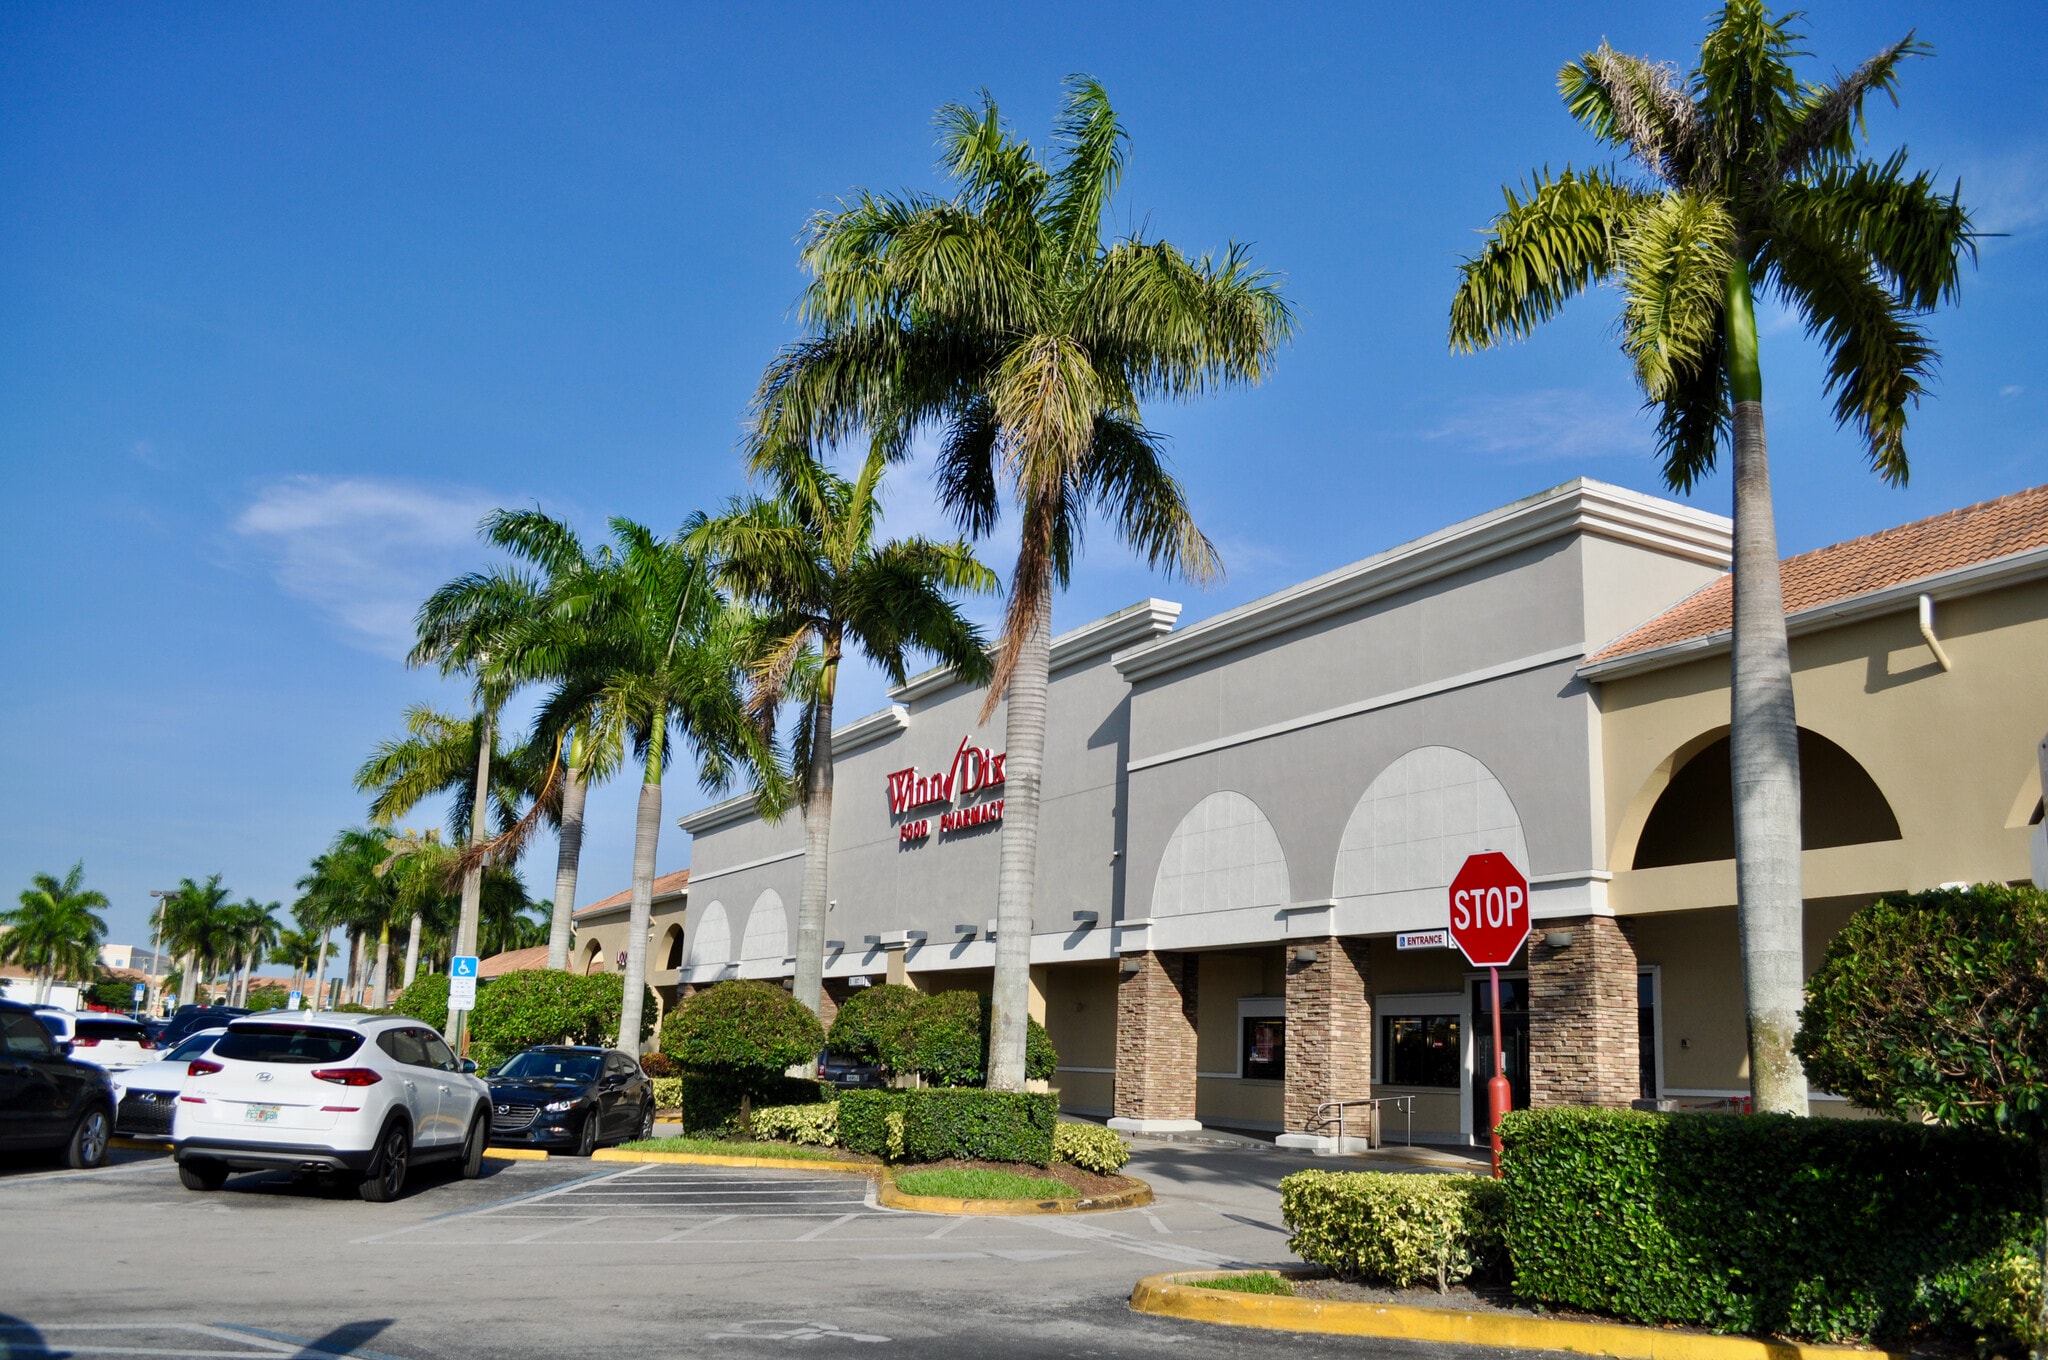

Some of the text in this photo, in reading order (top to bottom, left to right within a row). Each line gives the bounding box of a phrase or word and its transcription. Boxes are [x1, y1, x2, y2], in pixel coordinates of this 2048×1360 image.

[900, 800, 1005, 842] FOOD PHARMACY
[1455, 886, 1523, 930] STOP
[1407, 935, 1442, 945] ENTRANCE
